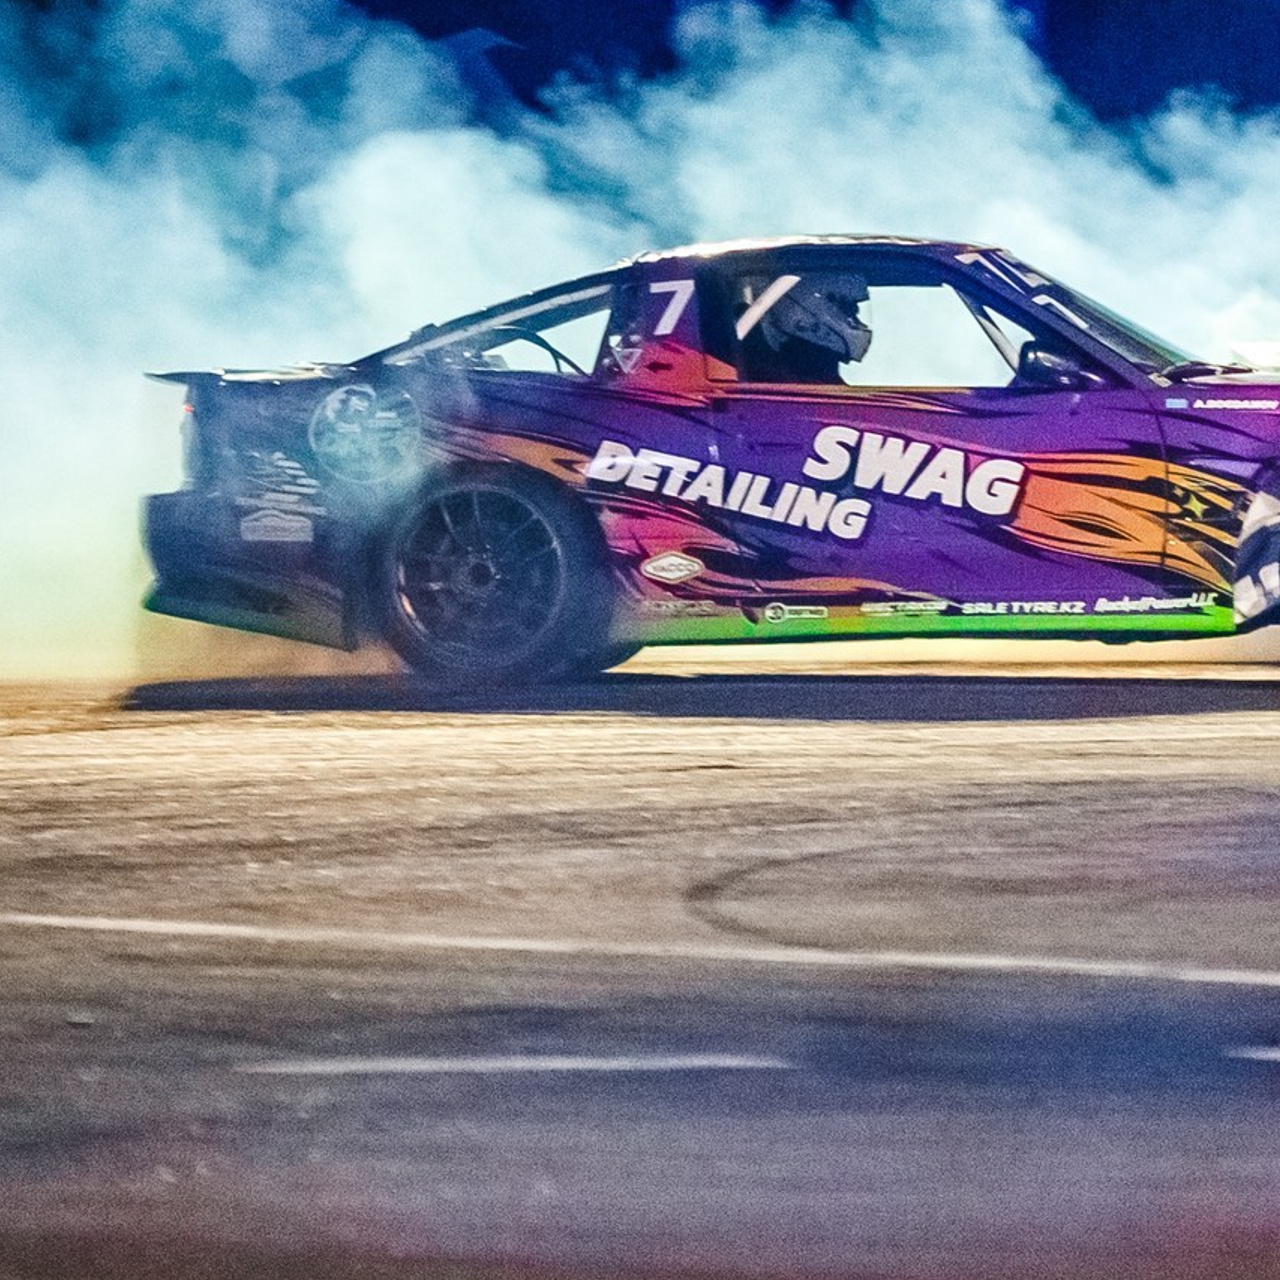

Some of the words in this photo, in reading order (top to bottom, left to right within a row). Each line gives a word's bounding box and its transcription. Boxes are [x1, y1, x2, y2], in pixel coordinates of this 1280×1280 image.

[649, 279, 695, 336] 7
[585, 440, 872, 539] DETAILING
[802, 425, 1026, 516] SWAG
